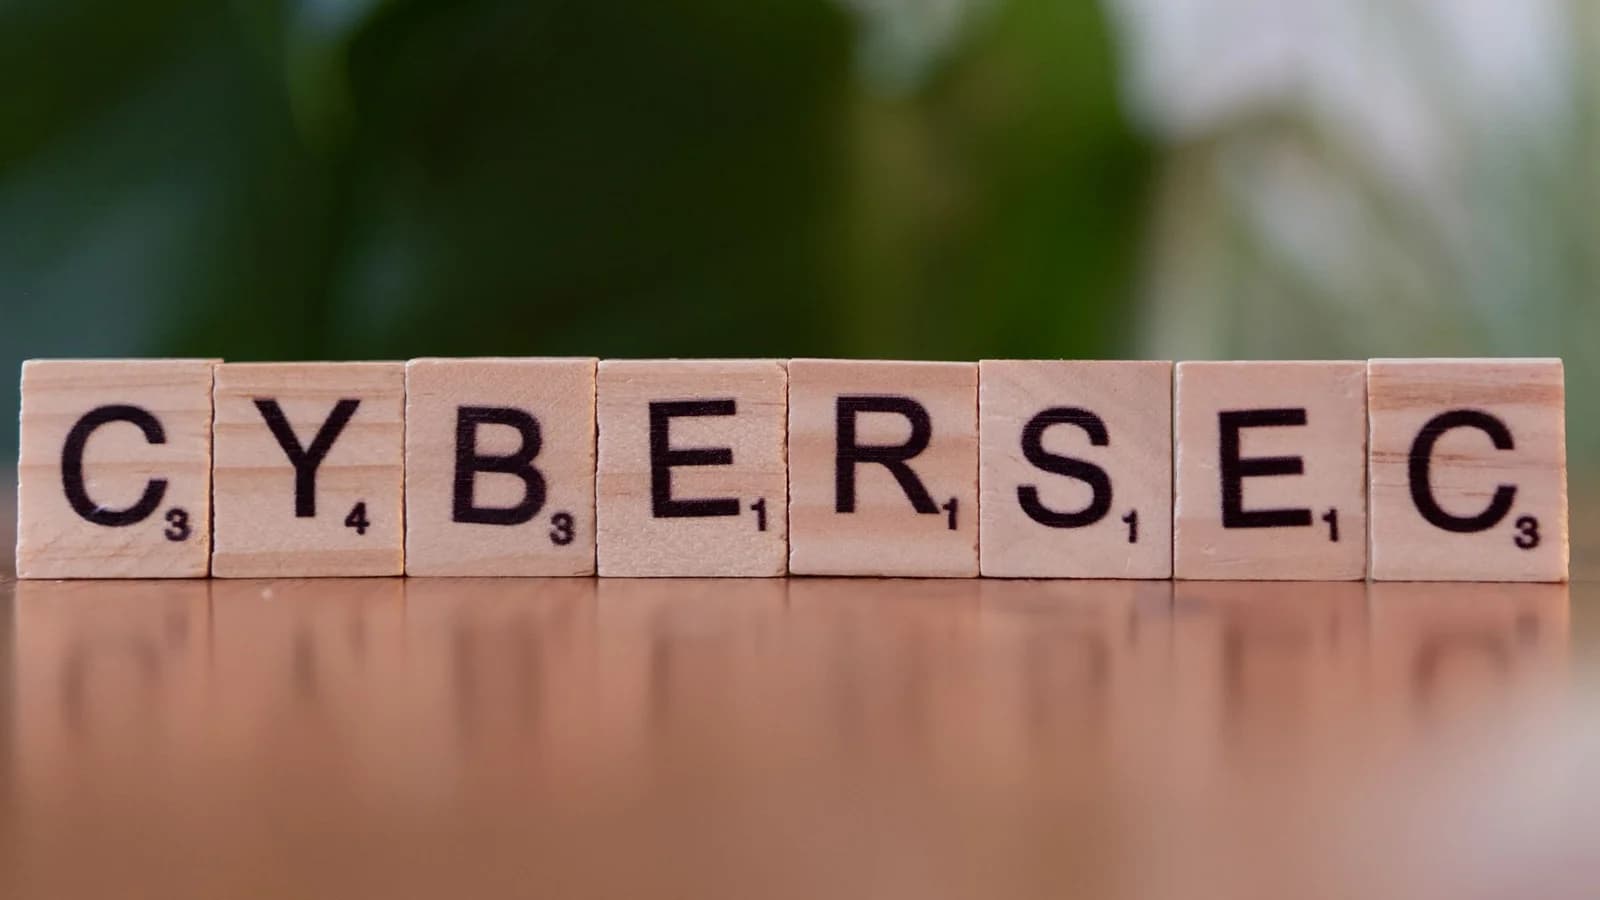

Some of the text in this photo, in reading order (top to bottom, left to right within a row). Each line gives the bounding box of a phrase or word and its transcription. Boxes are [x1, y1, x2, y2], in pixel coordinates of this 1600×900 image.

[164, 497, 1541, 551] 3 4 3 1 1 1 1 3
